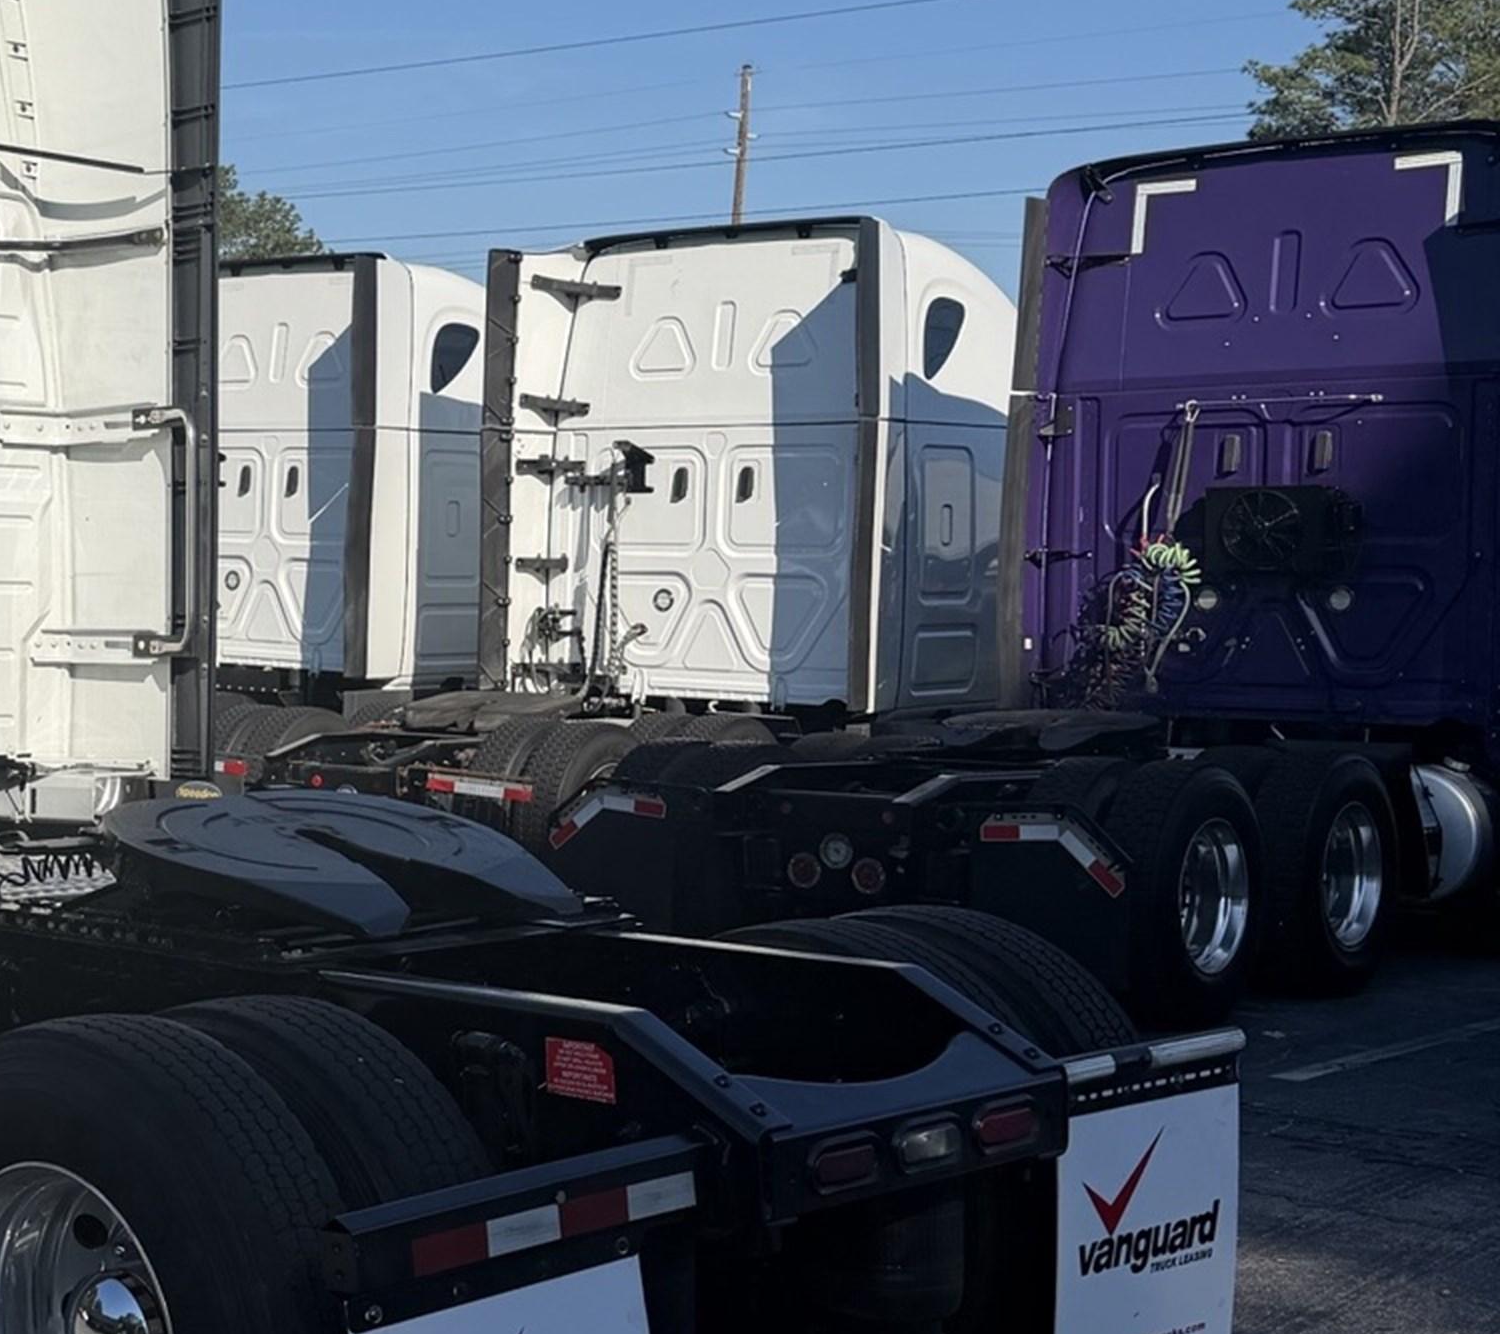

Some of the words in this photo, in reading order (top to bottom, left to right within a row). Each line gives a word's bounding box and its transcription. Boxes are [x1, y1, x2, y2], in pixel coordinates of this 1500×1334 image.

[1078, 1198, 1220, 1277] vanguard
[1150, 1255, 1177, 1274] TRUCK
[1178, 1247, 1213, 1267] LEASING
